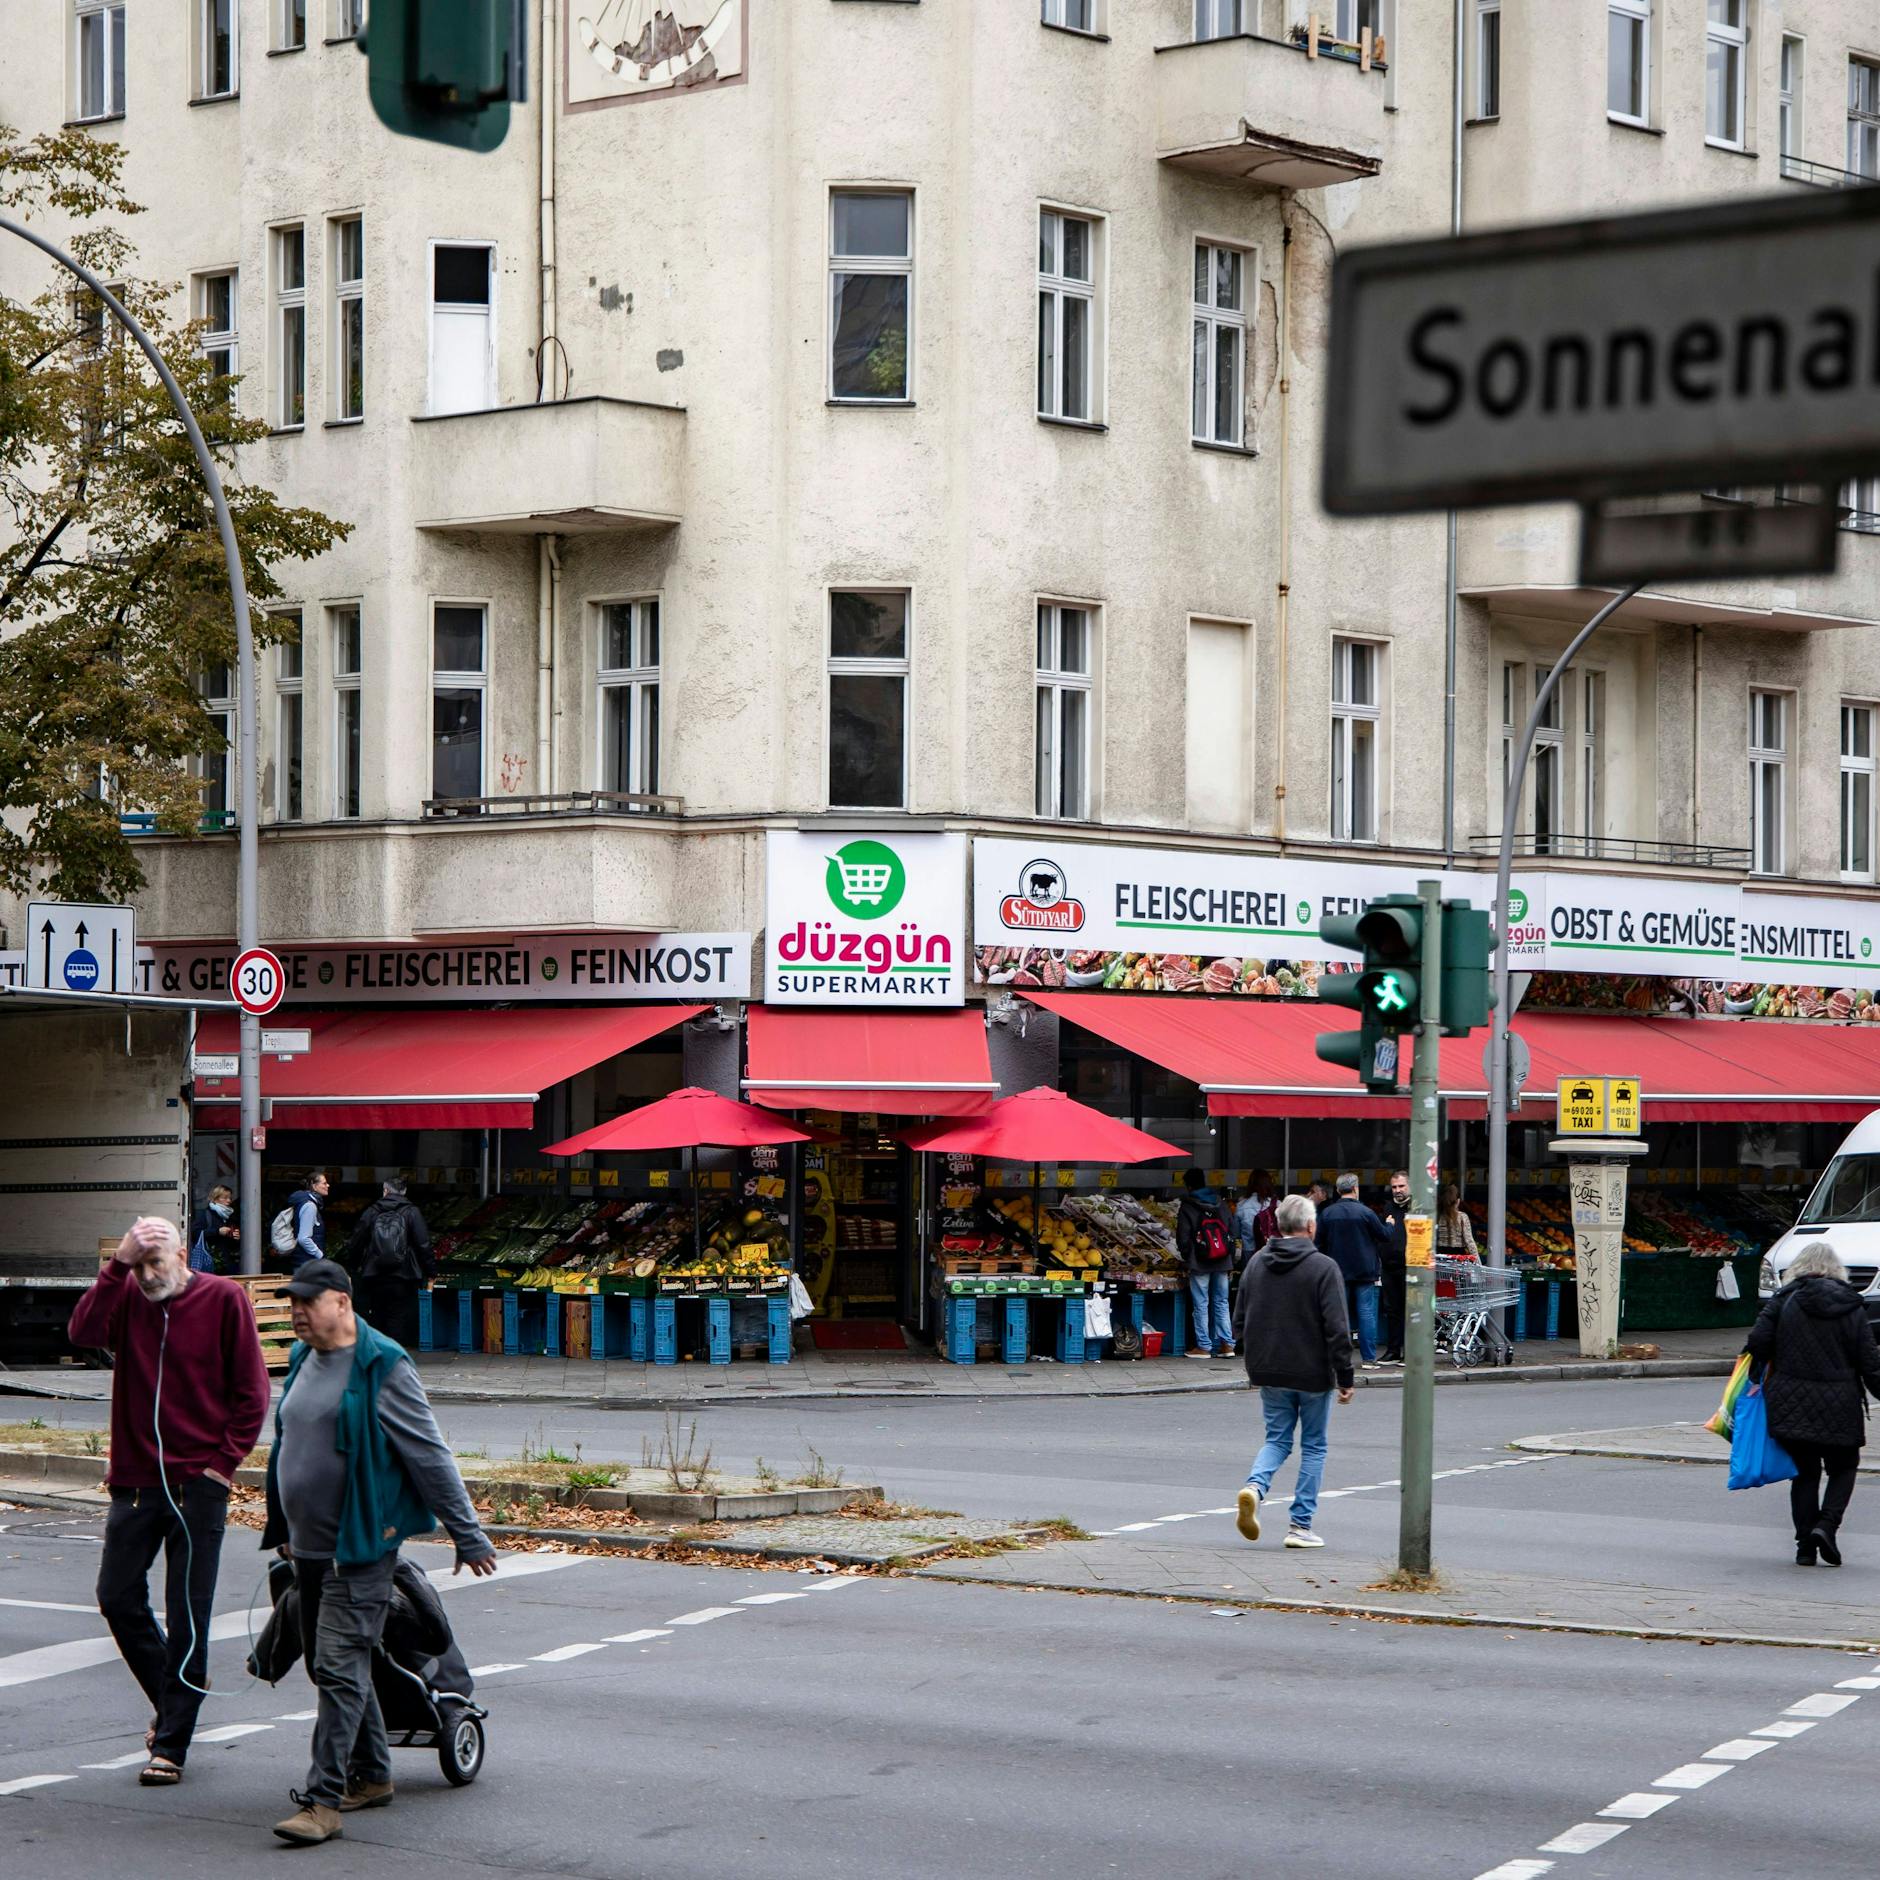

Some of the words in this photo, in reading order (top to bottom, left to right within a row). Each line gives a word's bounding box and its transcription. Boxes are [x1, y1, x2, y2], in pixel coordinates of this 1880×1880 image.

[1115, 883, 1286, 927] FLEISCHEREI
[1550, 906, 1613, 942] OBST
[1618, 910, 1635, 943] &
[1641, 908, 1736, 948] GEMÜSE
[778, 922, 951, 974] düzgün
[161, 958, 181, 992] &
[345, 950, 530, 988] FLEISCHEREI
[570, 947, 733, 984] FEINKOST
[243, 967, 273, 996] 30
[778, 975, 951, 994] SUPERMARKT
[194, 1059, 234, 1070] Sonnenallee
[1572, 1117, 1593, 1128] TAXI
[1616, 1117, 1631, 1128] TAXI
